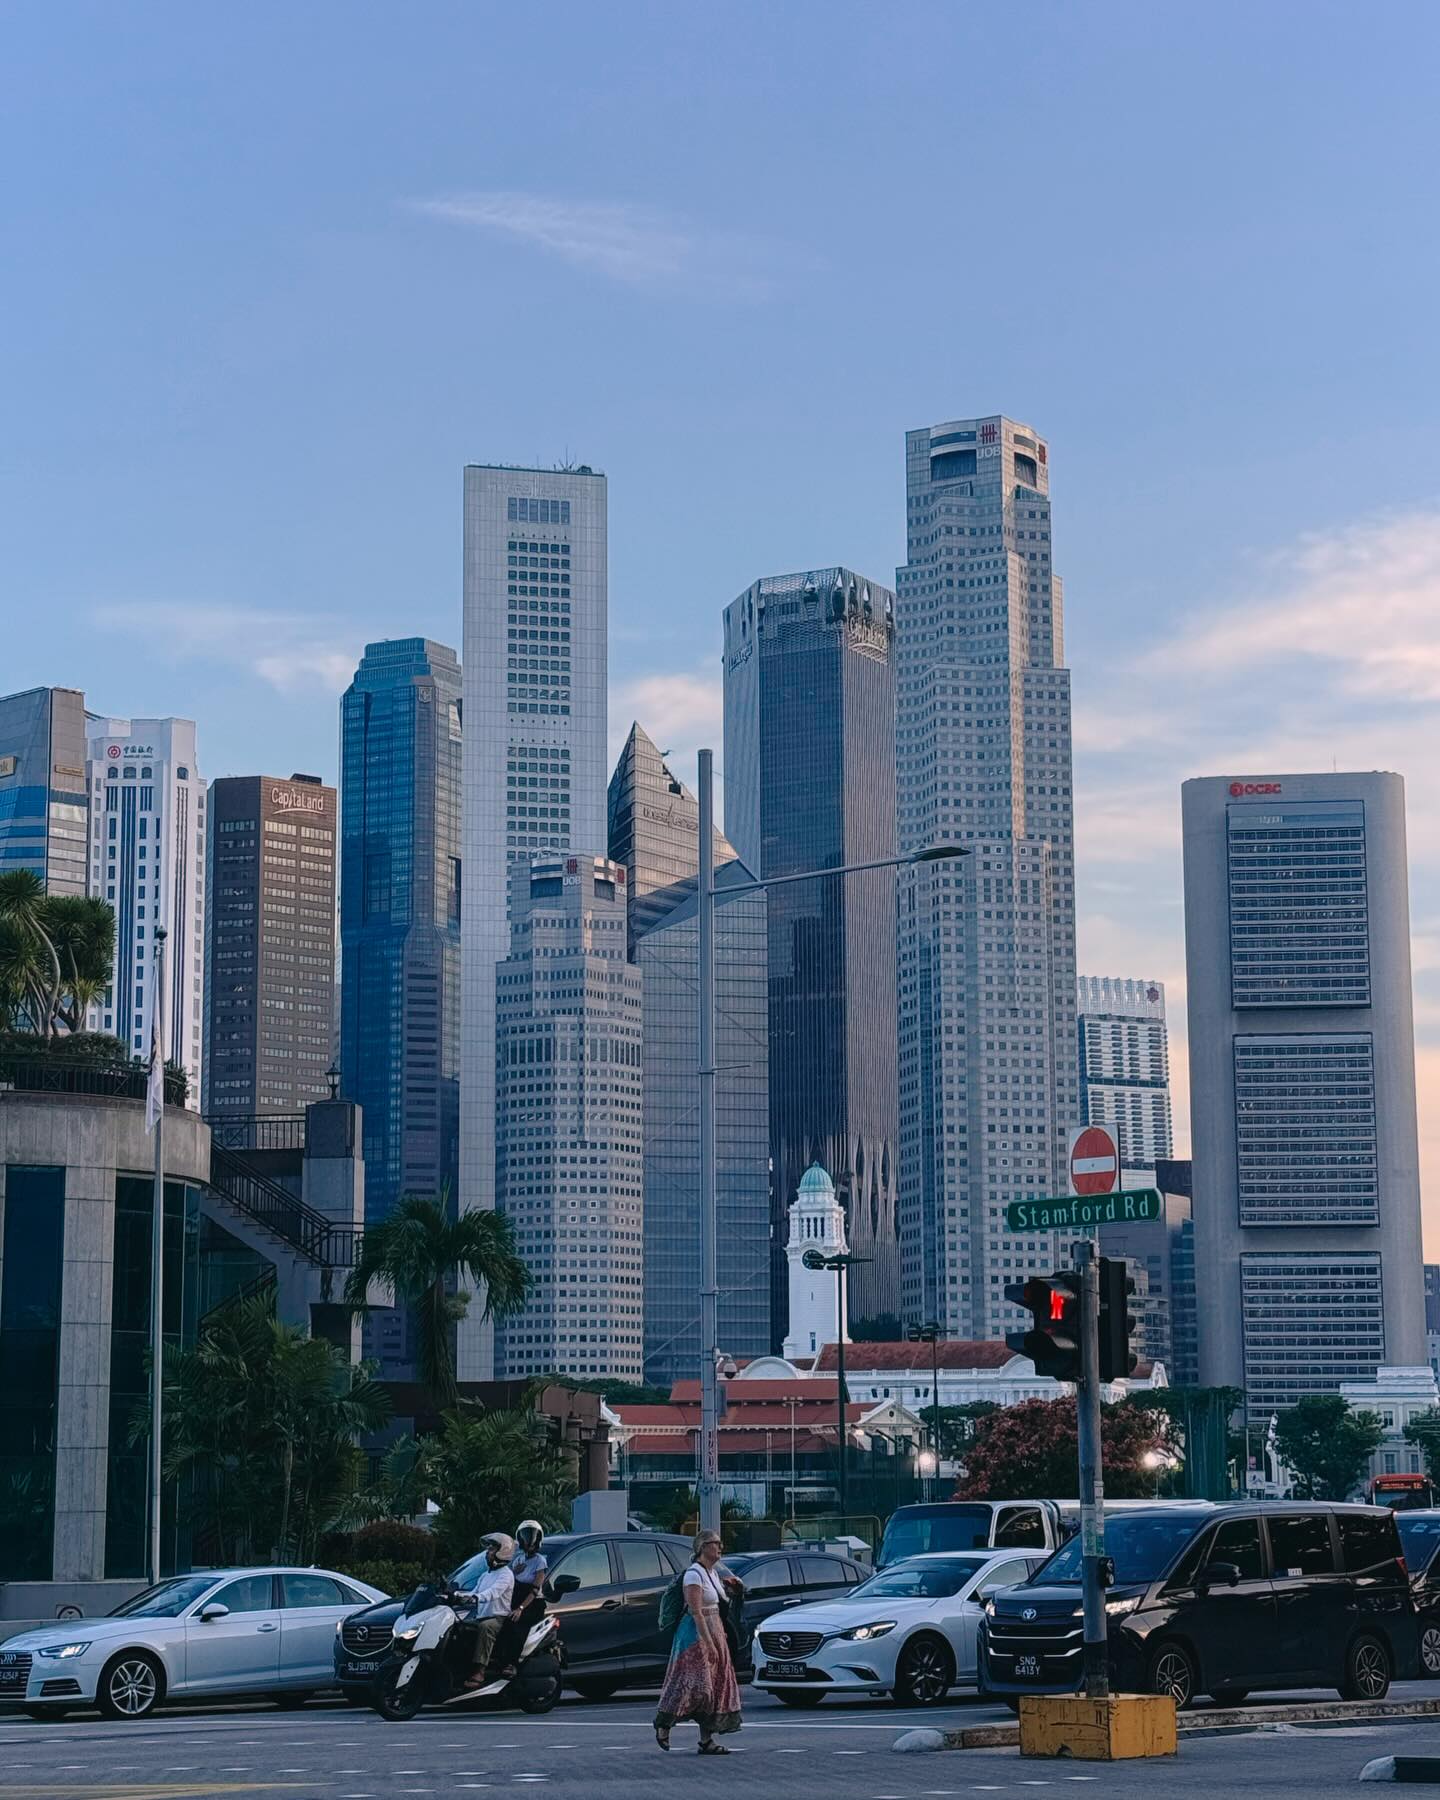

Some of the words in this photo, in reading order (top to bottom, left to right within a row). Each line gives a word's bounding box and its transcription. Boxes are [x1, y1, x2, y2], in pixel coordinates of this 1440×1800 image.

[271, 787, 324, 811] CapitaLand
[1017, 1198, 1116, 1228] Stamford
[1124, 1194, 1150, 1218] Rd
